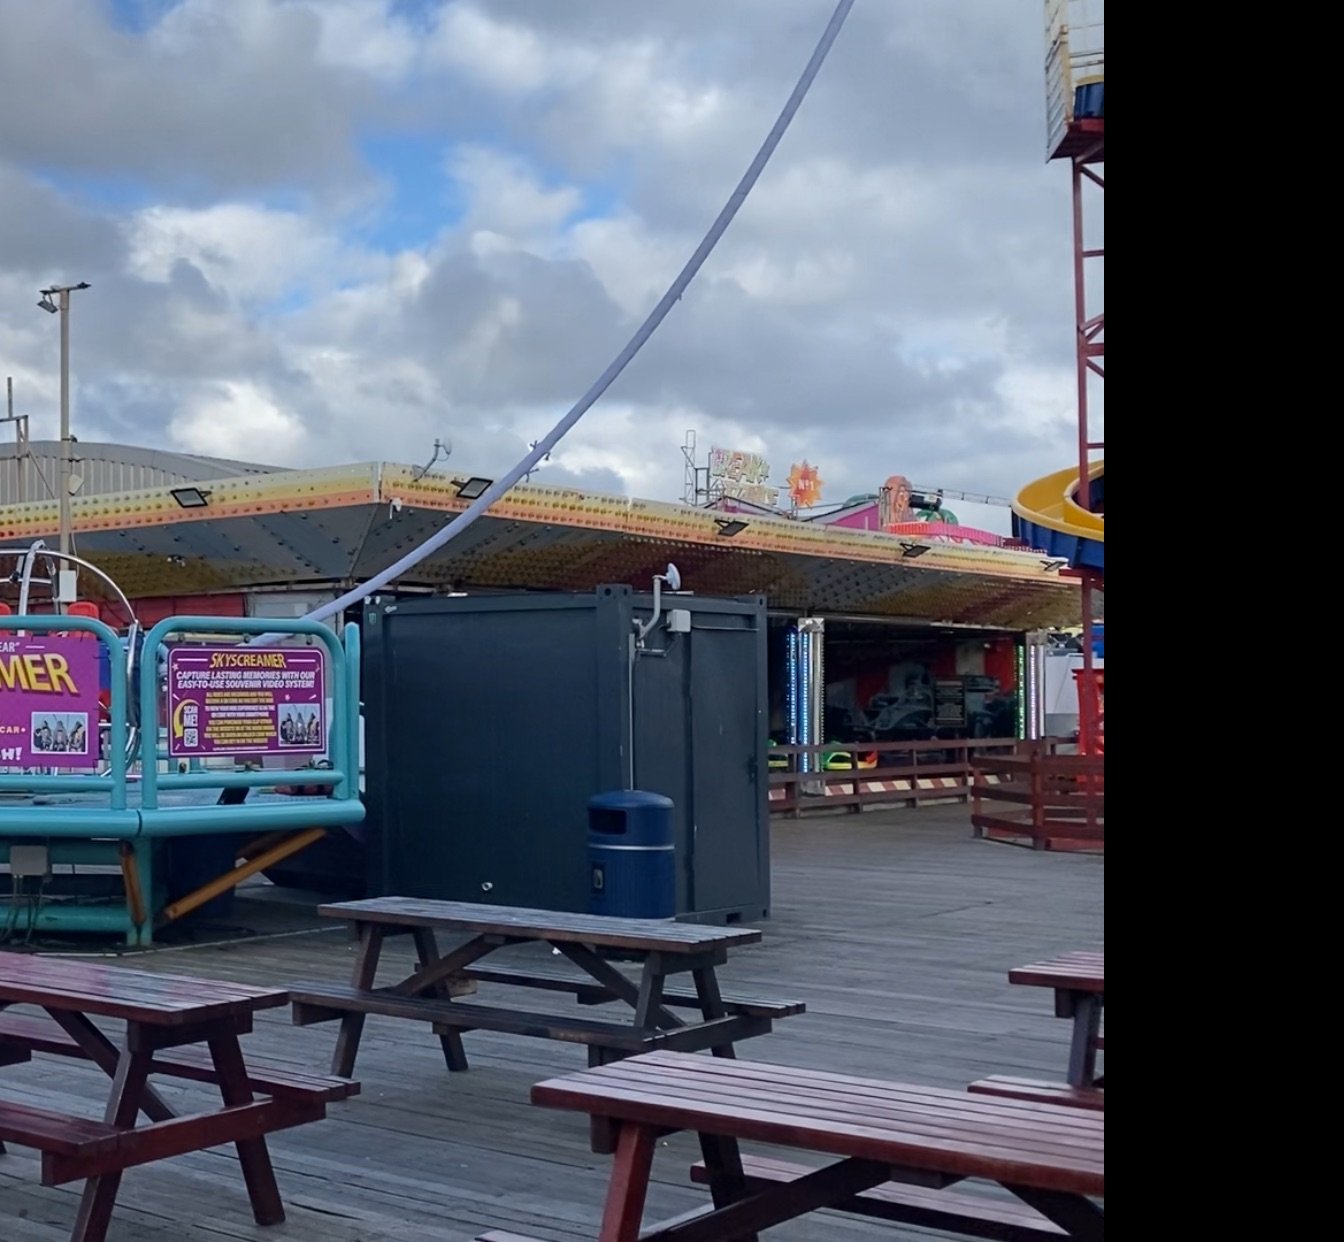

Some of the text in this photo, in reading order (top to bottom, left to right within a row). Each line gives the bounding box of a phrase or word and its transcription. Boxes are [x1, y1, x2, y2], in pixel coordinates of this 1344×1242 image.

[209, 653, 287, 668] SKYSCREAMER
[176, 671, 316, 680] CAPTURE LASTING MEMORIES WITH OUR
[178, 680, 224, 689] EASY-TO-USE
[226, 680, 262, 689] SOUVENIR
[262, 680, 284, 688] VIDEO
